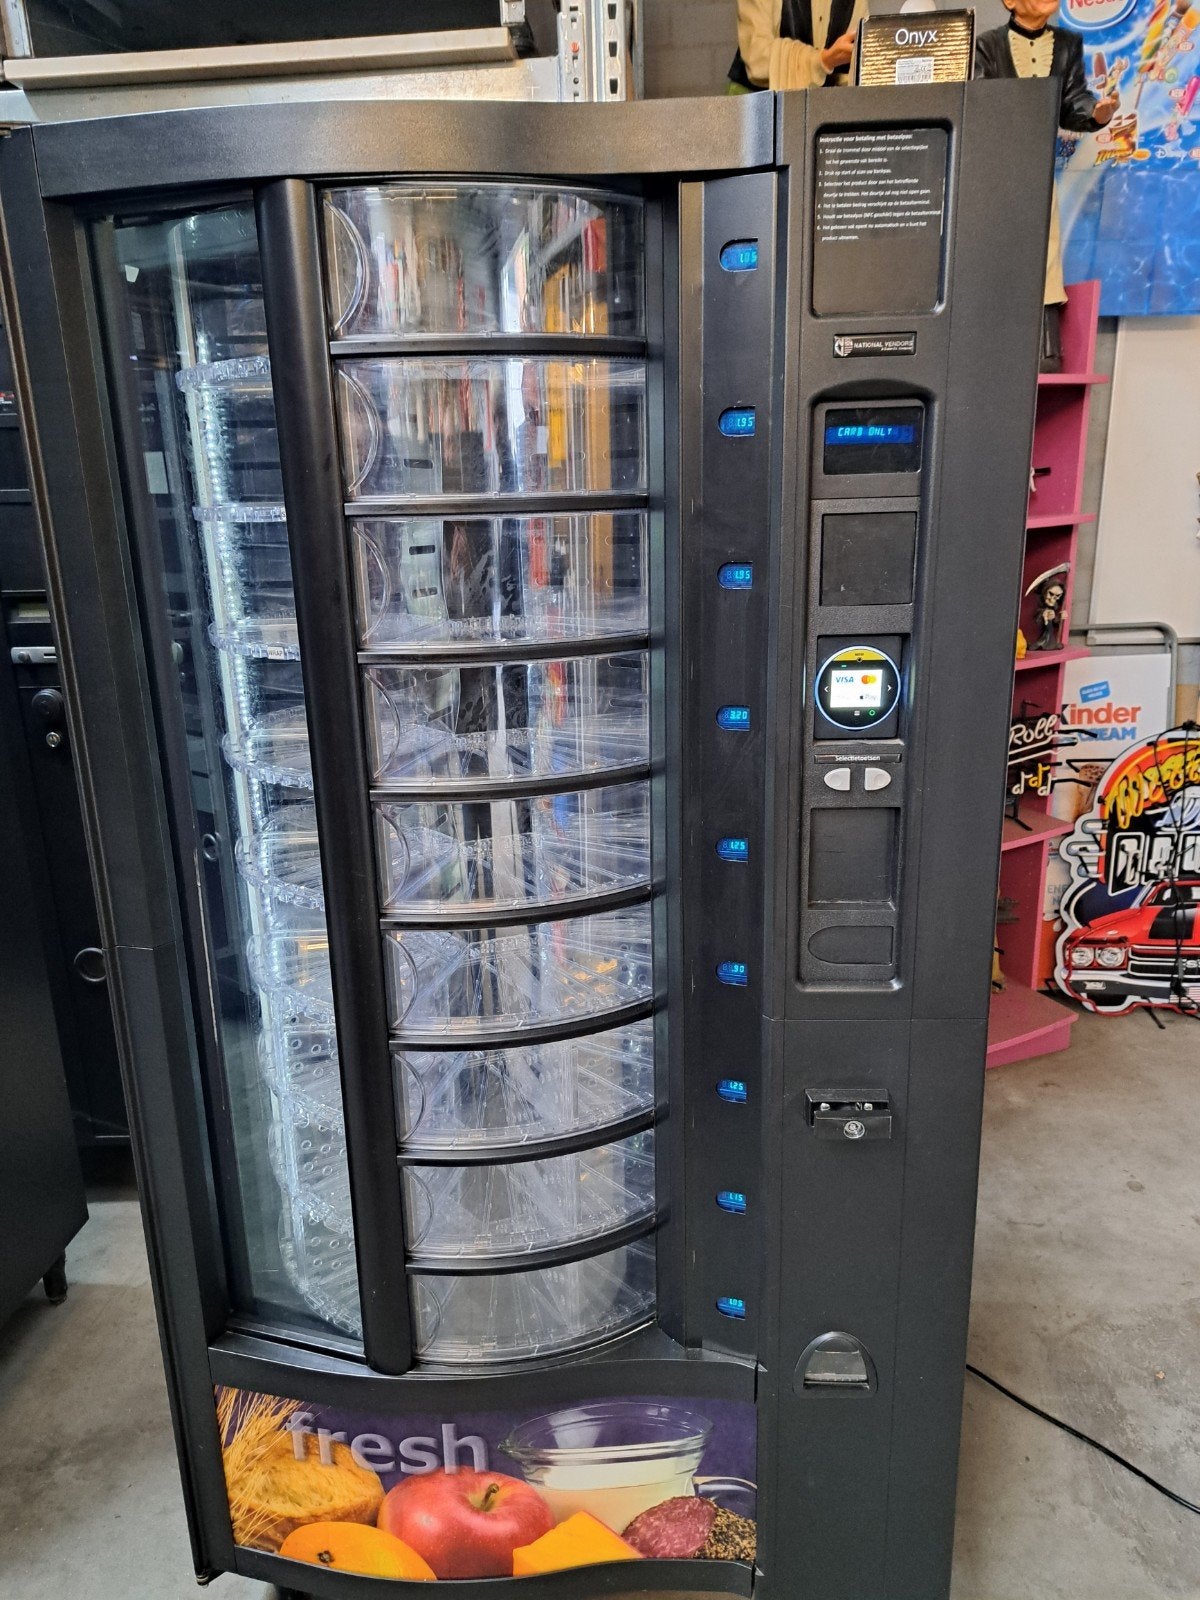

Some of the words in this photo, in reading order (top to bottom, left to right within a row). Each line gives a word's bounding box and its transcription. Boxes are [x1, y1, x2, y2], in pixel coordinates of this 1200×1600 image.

[895, 28, 938, 47] Onyx
[853, 341, 883, 349] NATIONAL
[1009, 714, 1058, 745] Roll
[286, 1411, 489, 1475] fresh
